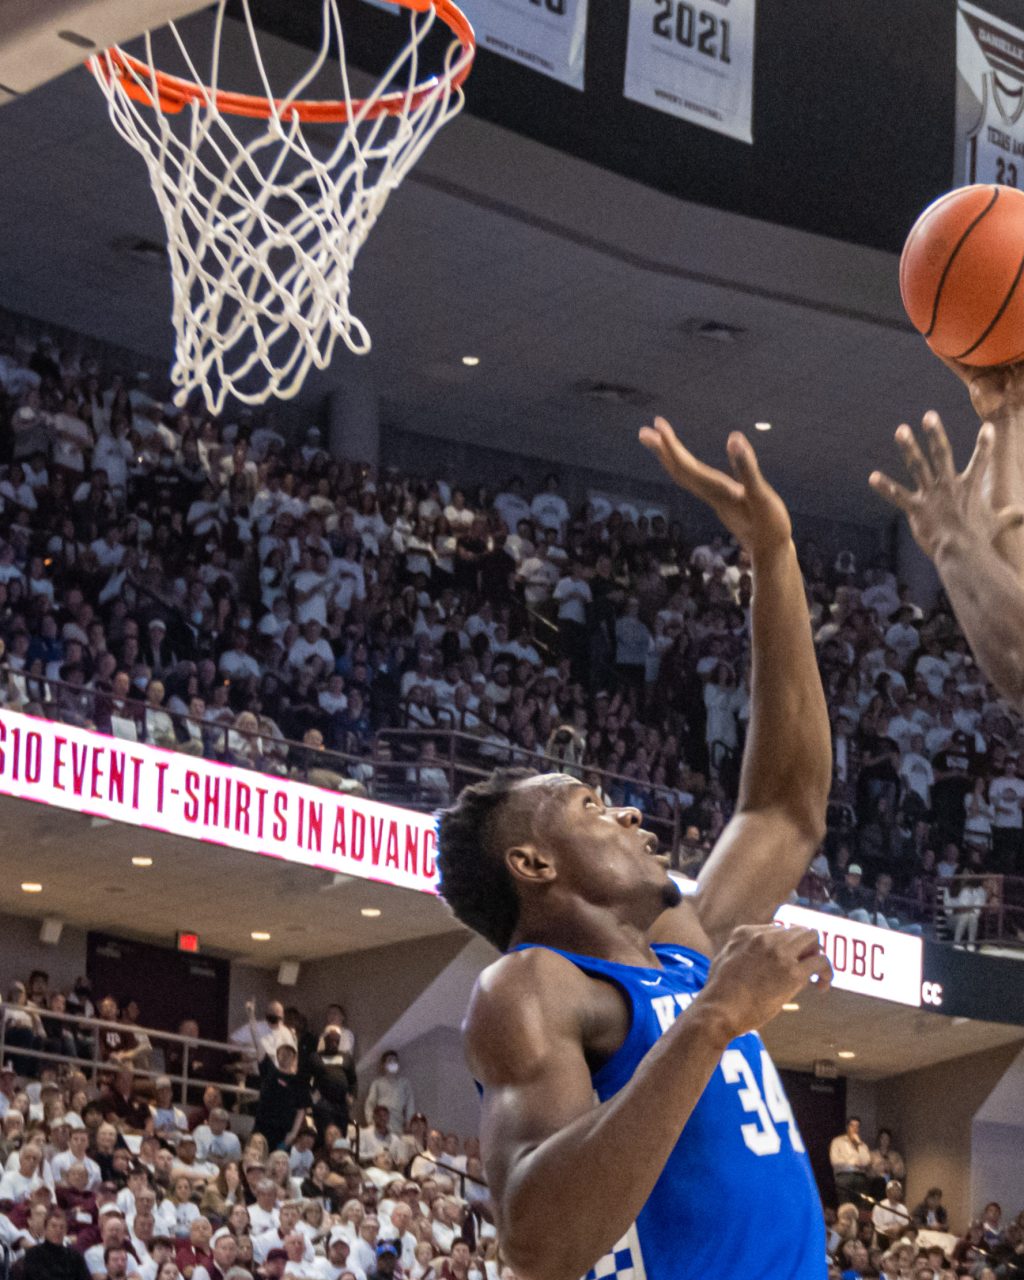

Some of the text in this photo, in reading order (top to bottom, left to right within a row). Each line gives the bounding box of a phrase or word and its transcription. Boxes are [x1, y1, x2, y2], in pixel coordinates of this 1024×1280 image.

[652, 0, 731, 64] 2021
[53, 735, 144, 810] EVENT
[155, 762, 289, 843] T-SHIRTS
[297, 796, 323, 853] IN
[720, 1049, 806, 1157] 34
